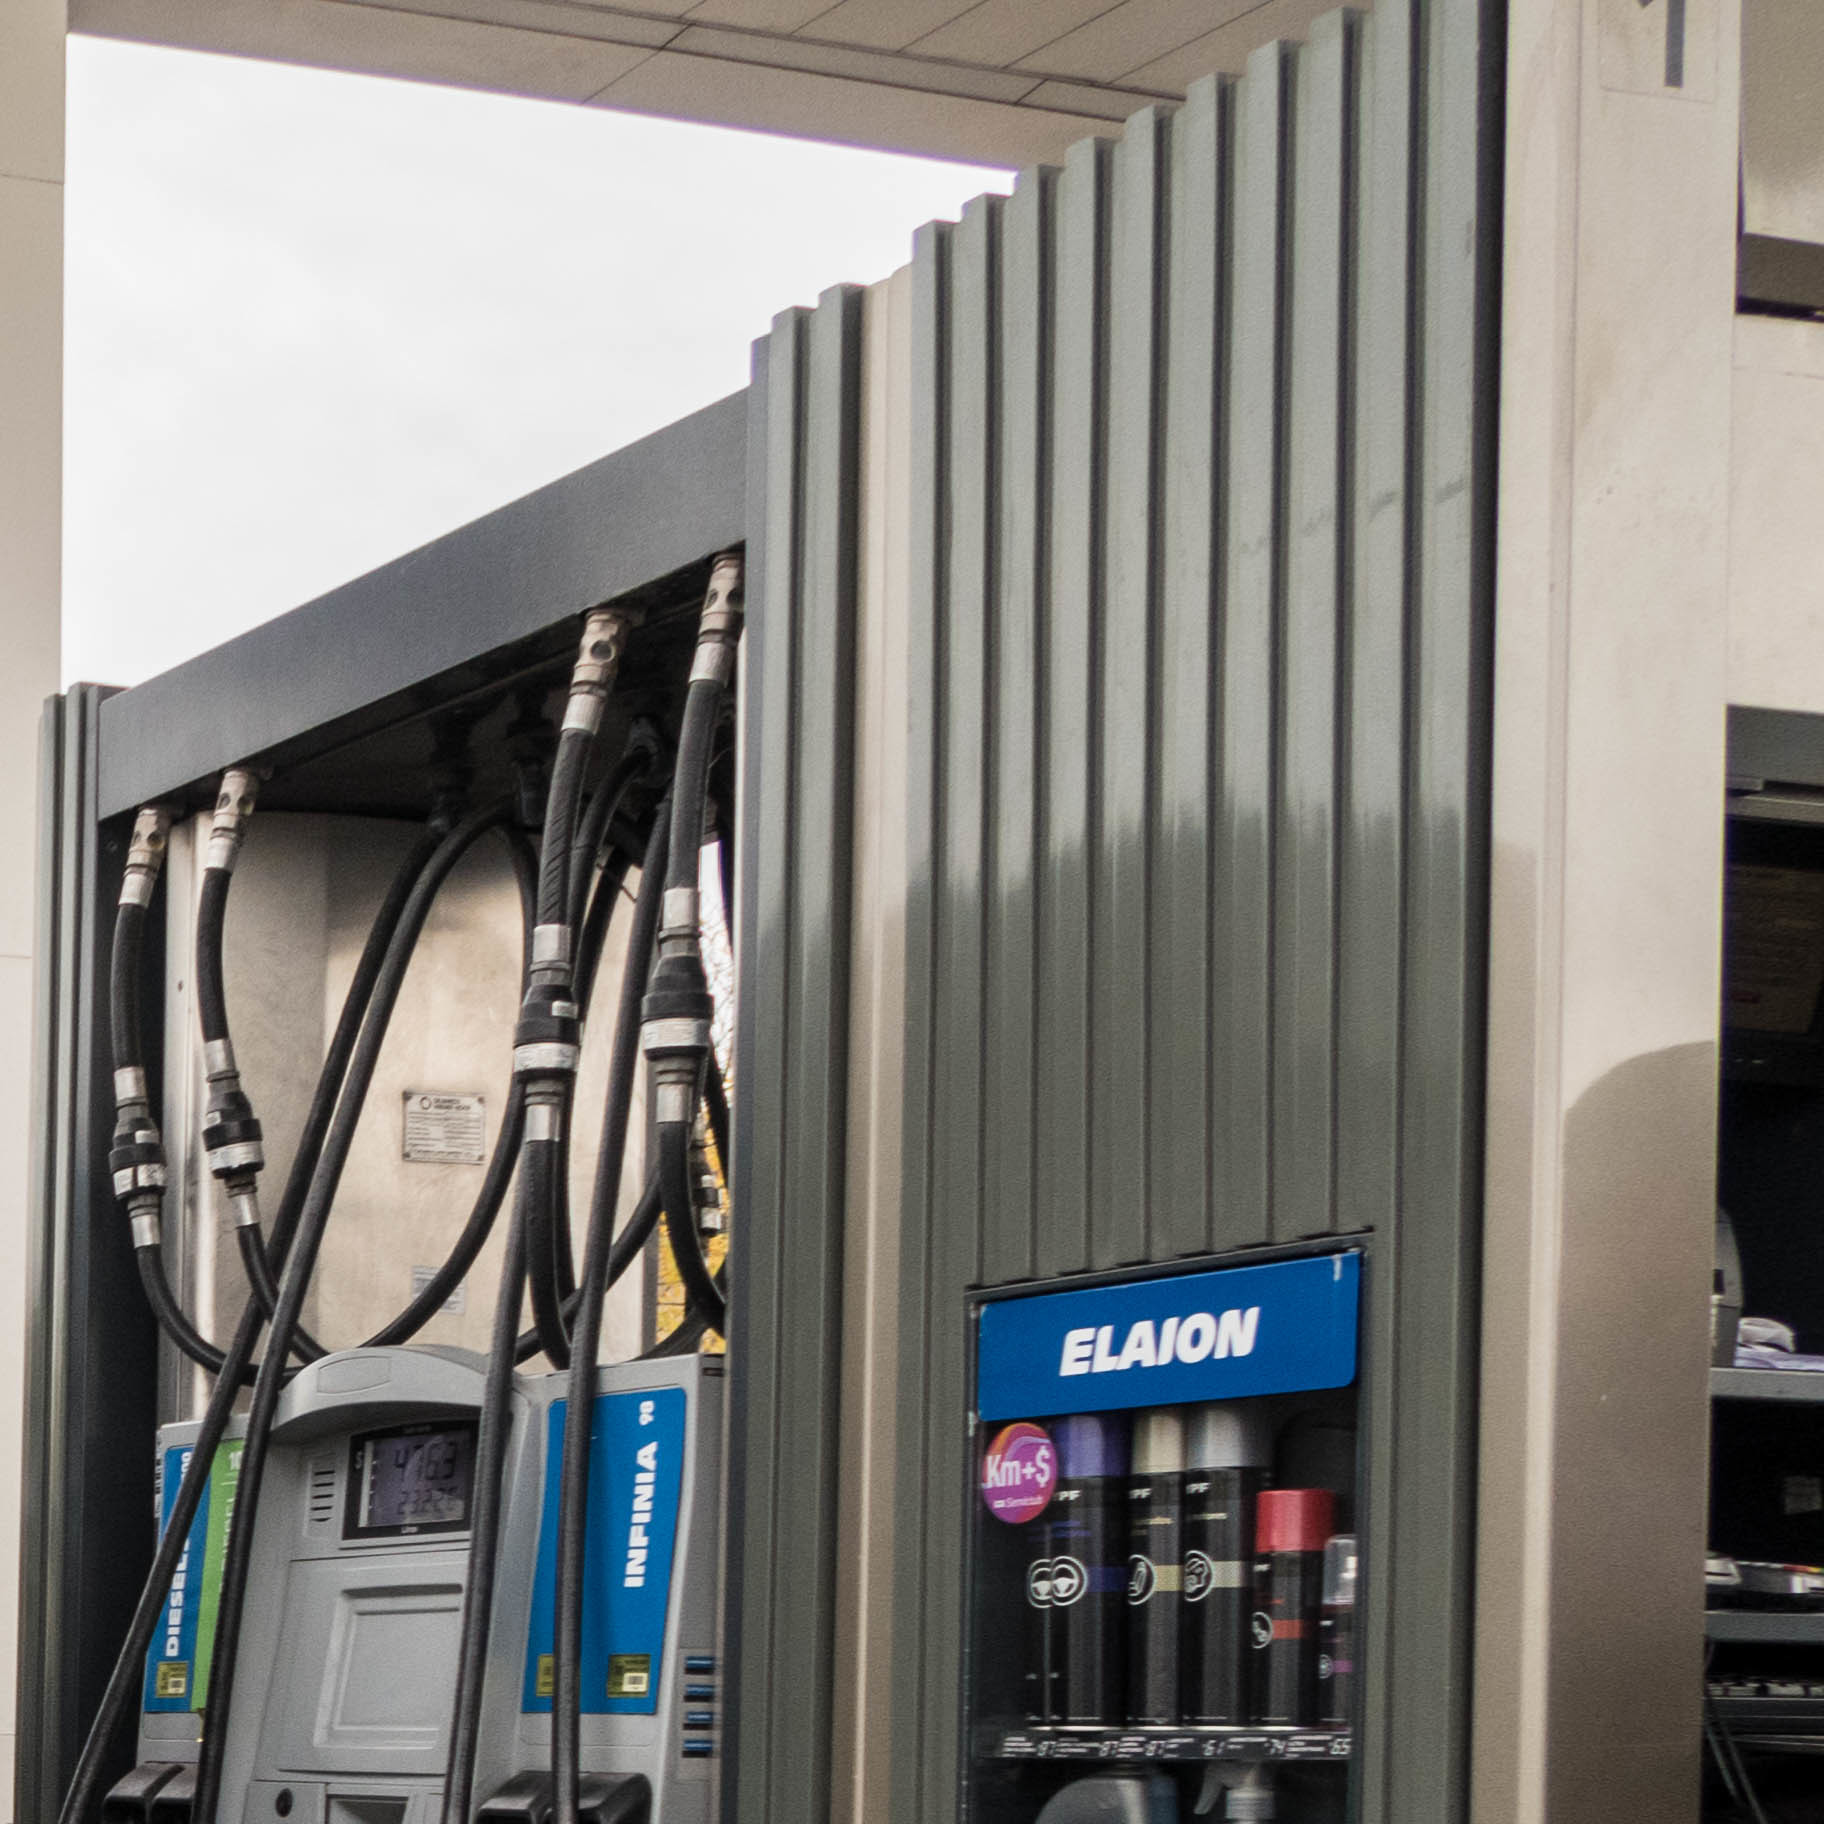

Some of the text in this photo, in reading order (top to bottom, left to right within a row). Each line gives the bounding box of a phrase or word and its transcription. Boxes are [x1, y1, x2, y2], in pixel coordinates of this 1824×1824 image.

[1059, 1306, 1261, 1377] ELAION
[985, 1445, 1051, 1489] Km+$
[623, 1441, 658, 1588] INFINIA
